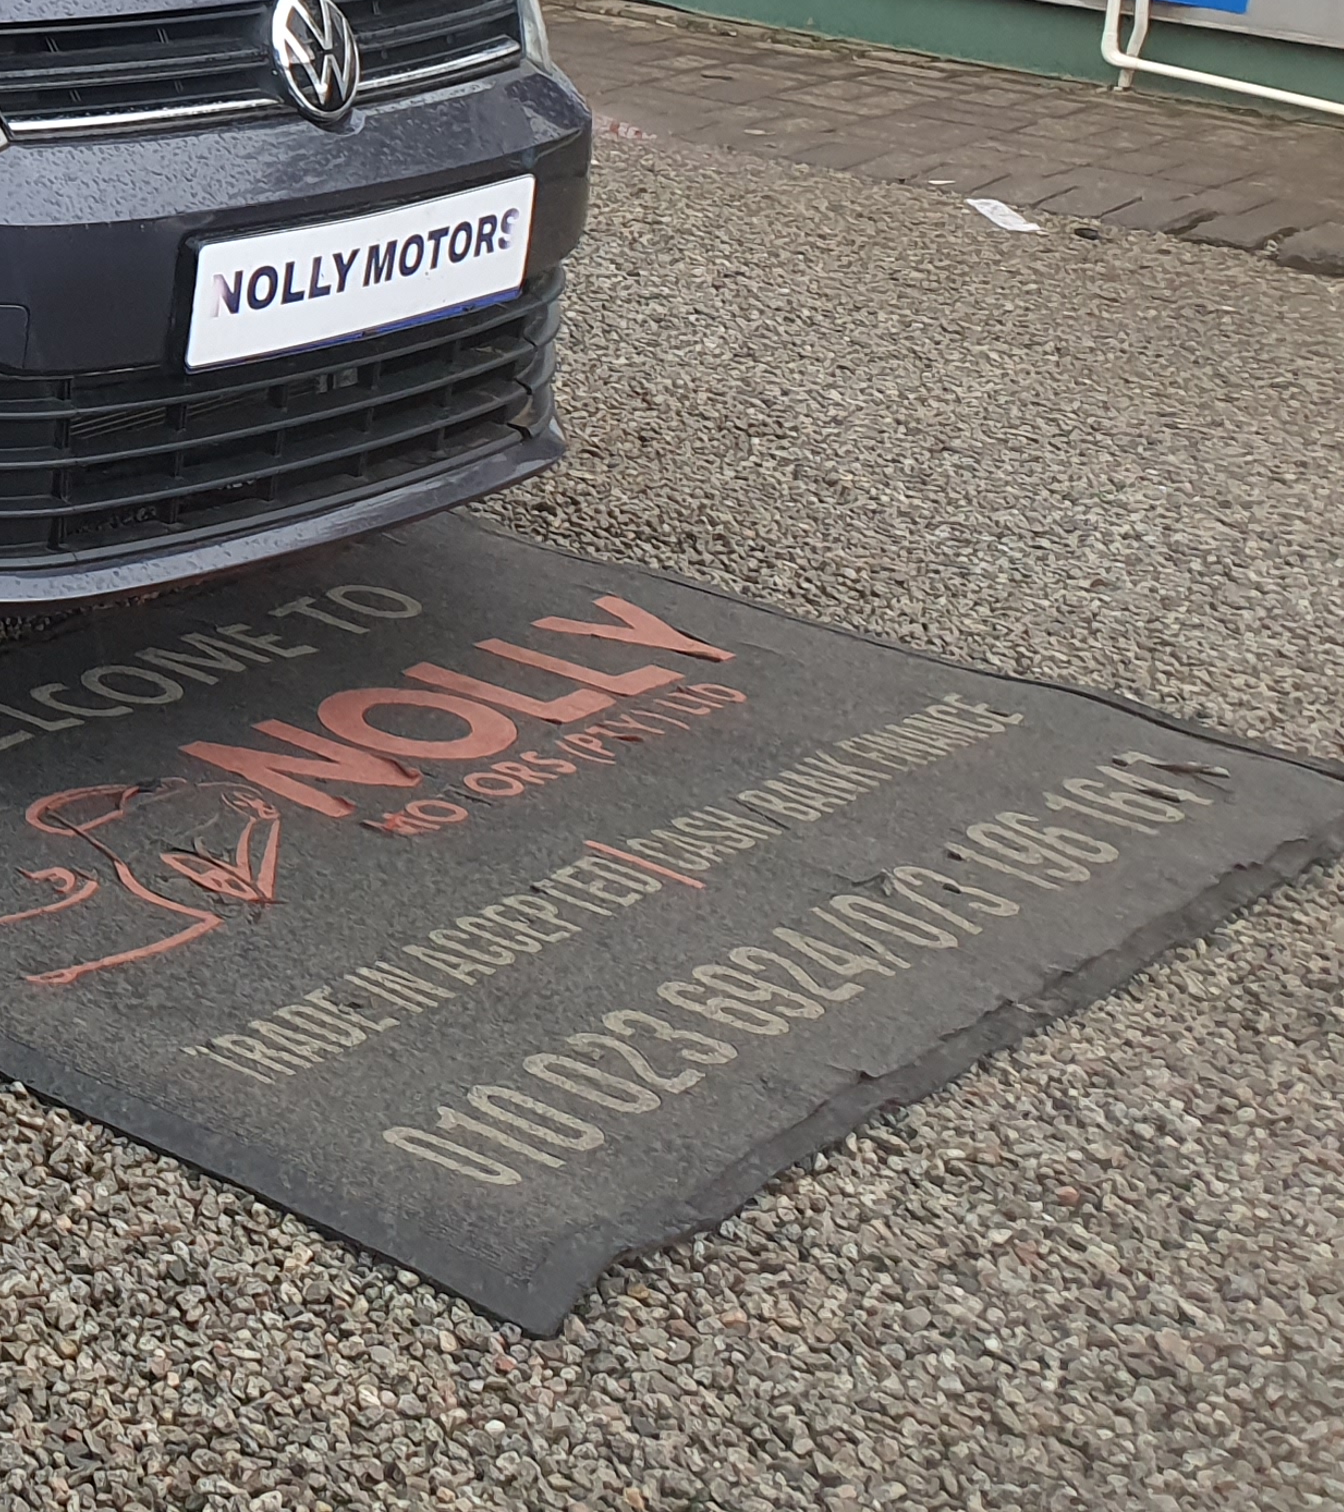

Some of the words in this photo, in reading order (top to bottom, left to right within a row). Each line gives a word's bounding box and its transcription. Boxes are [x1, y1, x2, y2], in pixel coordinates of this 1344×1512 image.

[212, 246, 361, 318] NOLLY
[361, 206, 521, 288] MOTORS
[267, 583, 424, 635] TO
[177, 594, 737, 819] NOLLY
[180, 985, 401, 1086] TRADE
[343, 960, 457, 1014] IN
[382, 1084, 606, 1186] 010
[522, 1008, 739, 1114] 023
[943, 810, 1120, 890] 196
